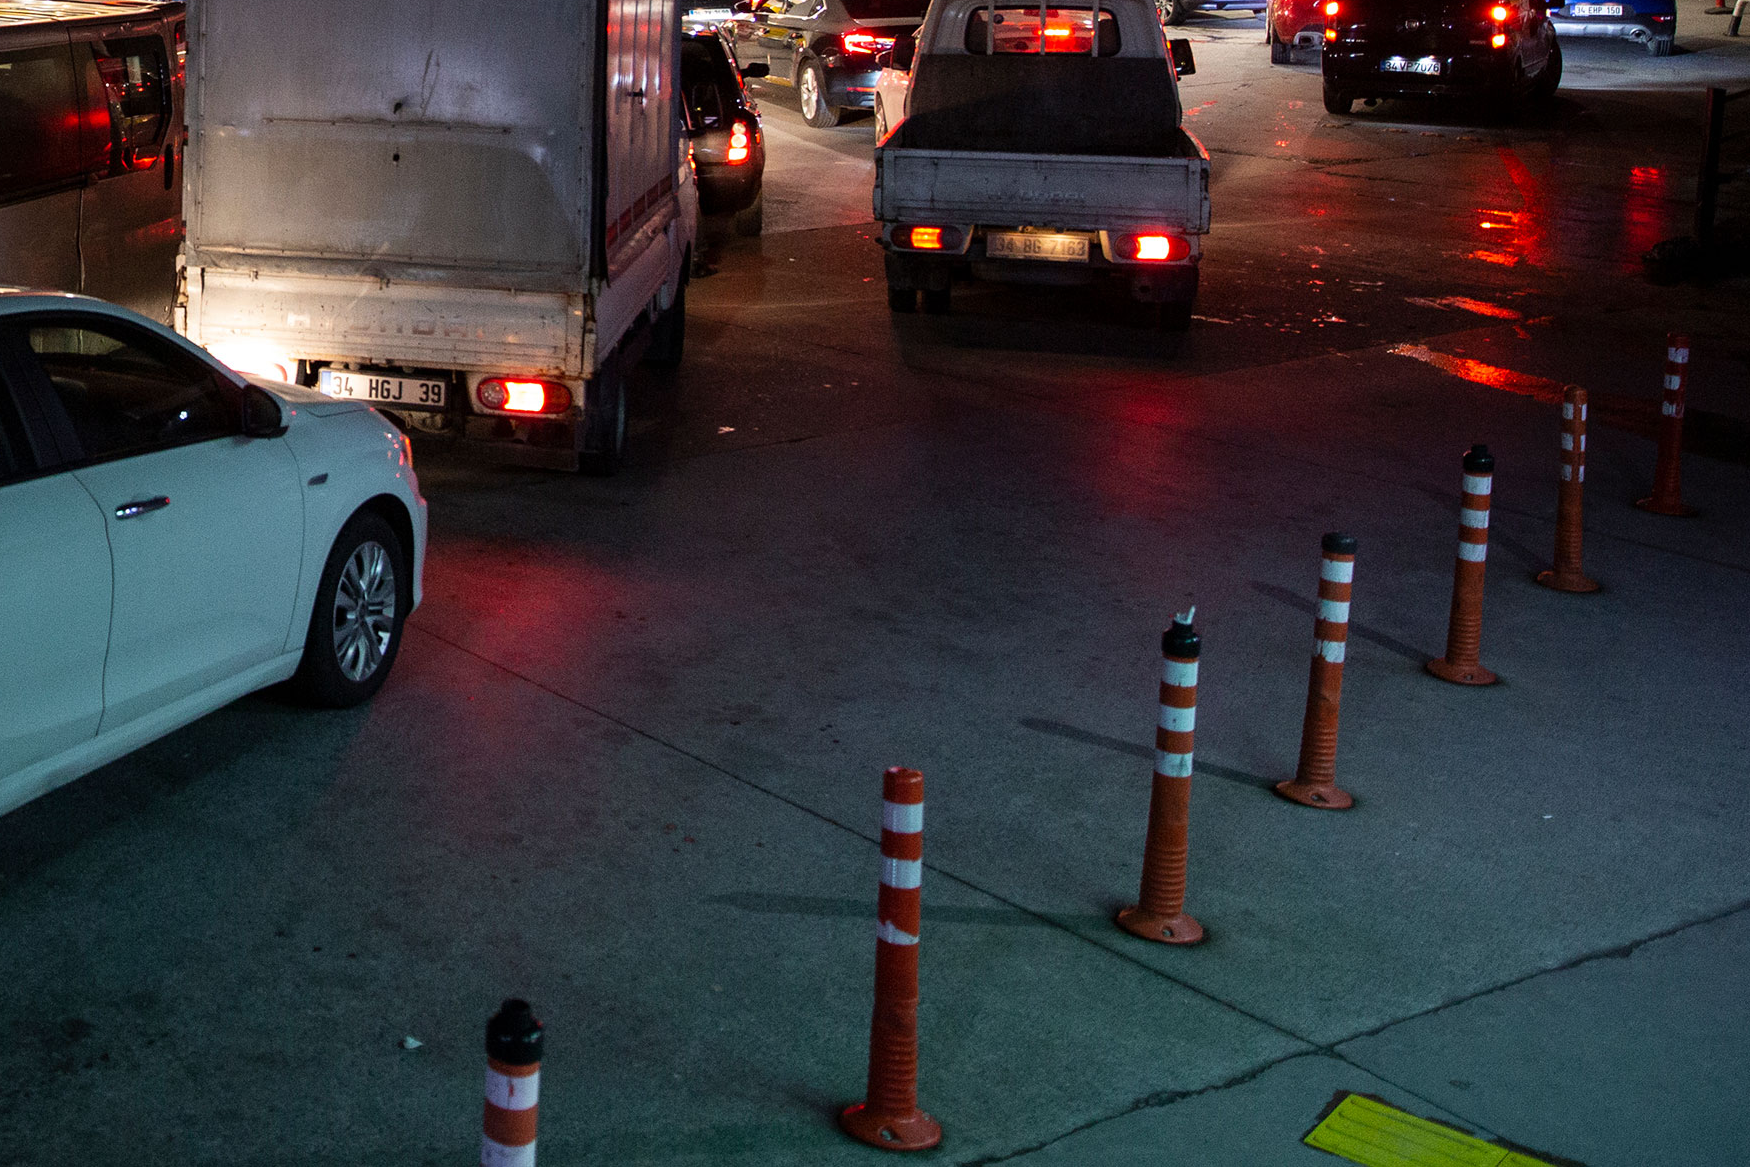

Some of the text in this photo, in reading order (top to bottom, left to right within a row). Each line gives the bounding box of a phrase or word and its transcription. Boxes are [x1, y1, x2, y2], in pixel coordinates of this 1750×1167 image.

[1385, 61, 1398, 70] 34
[332, 376, 442, 404] 34 HGJ 39
